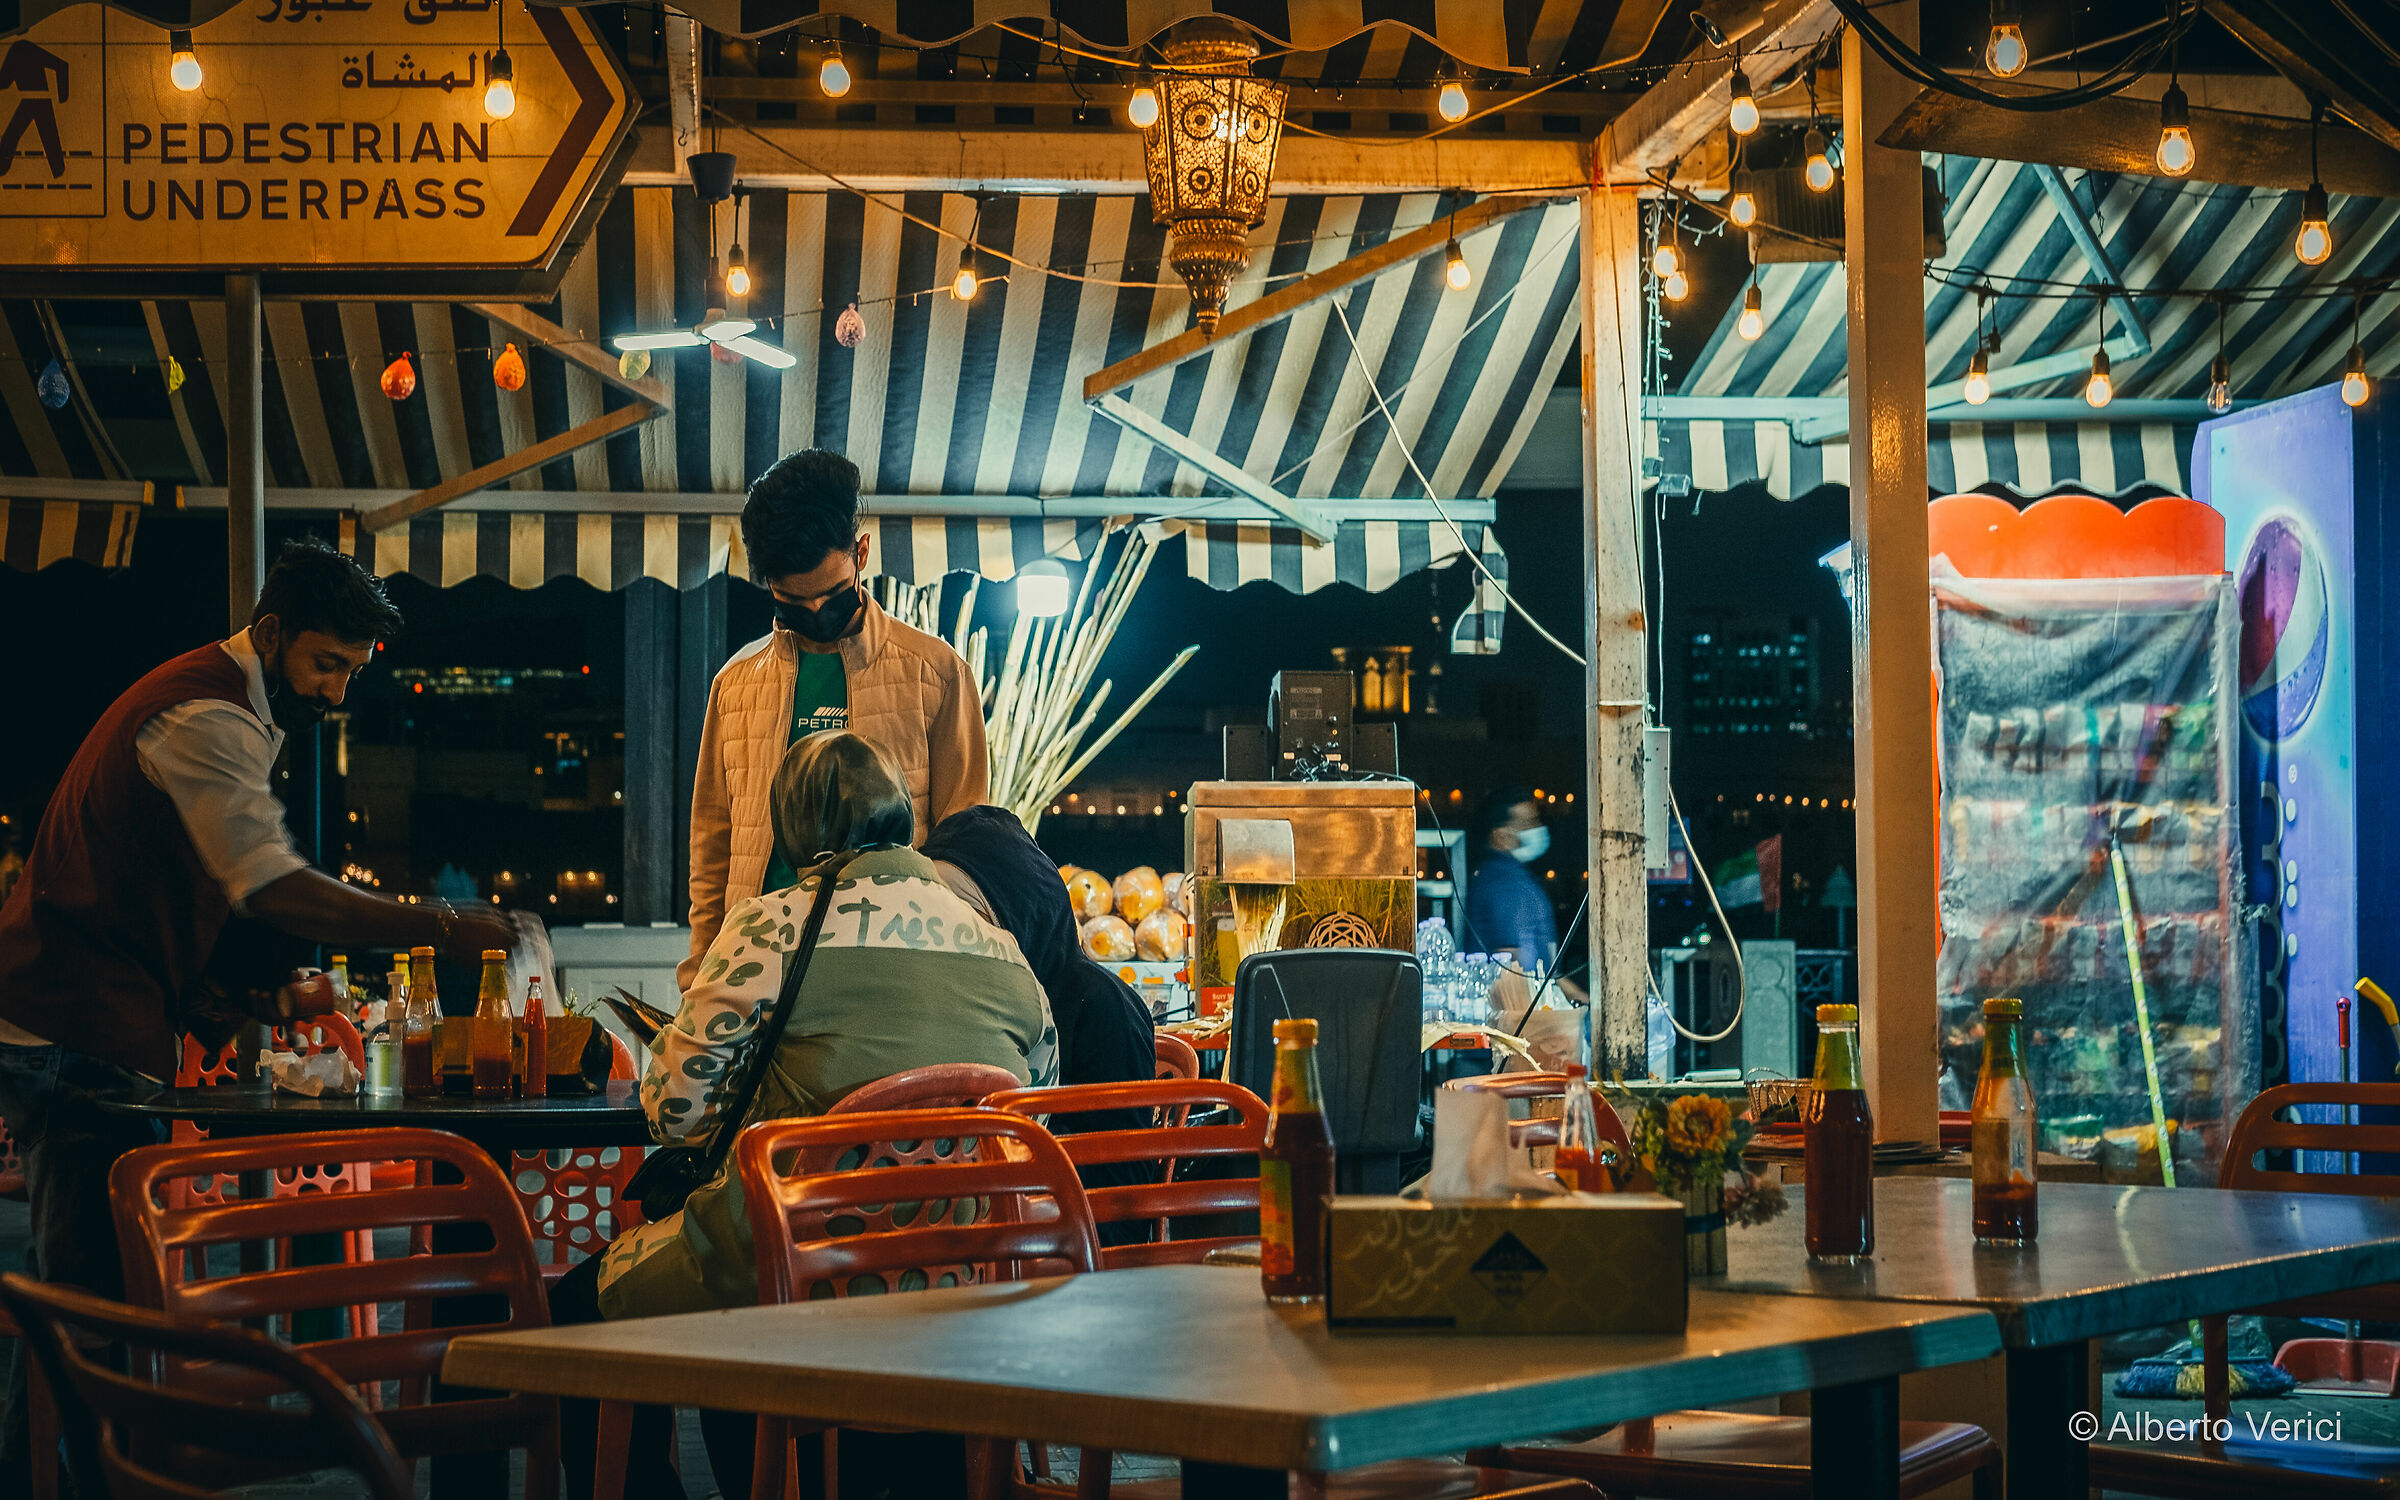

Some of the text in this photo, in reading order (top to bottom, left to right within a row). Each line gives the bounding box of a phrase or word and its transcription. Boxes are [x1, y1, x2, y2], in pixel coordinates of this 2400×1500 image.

[341, 50, 492, 94] المشاة
[124, 122, 488, 164] PEDESTRIAN
[123, 178, 486, 221] UNDERPASS
